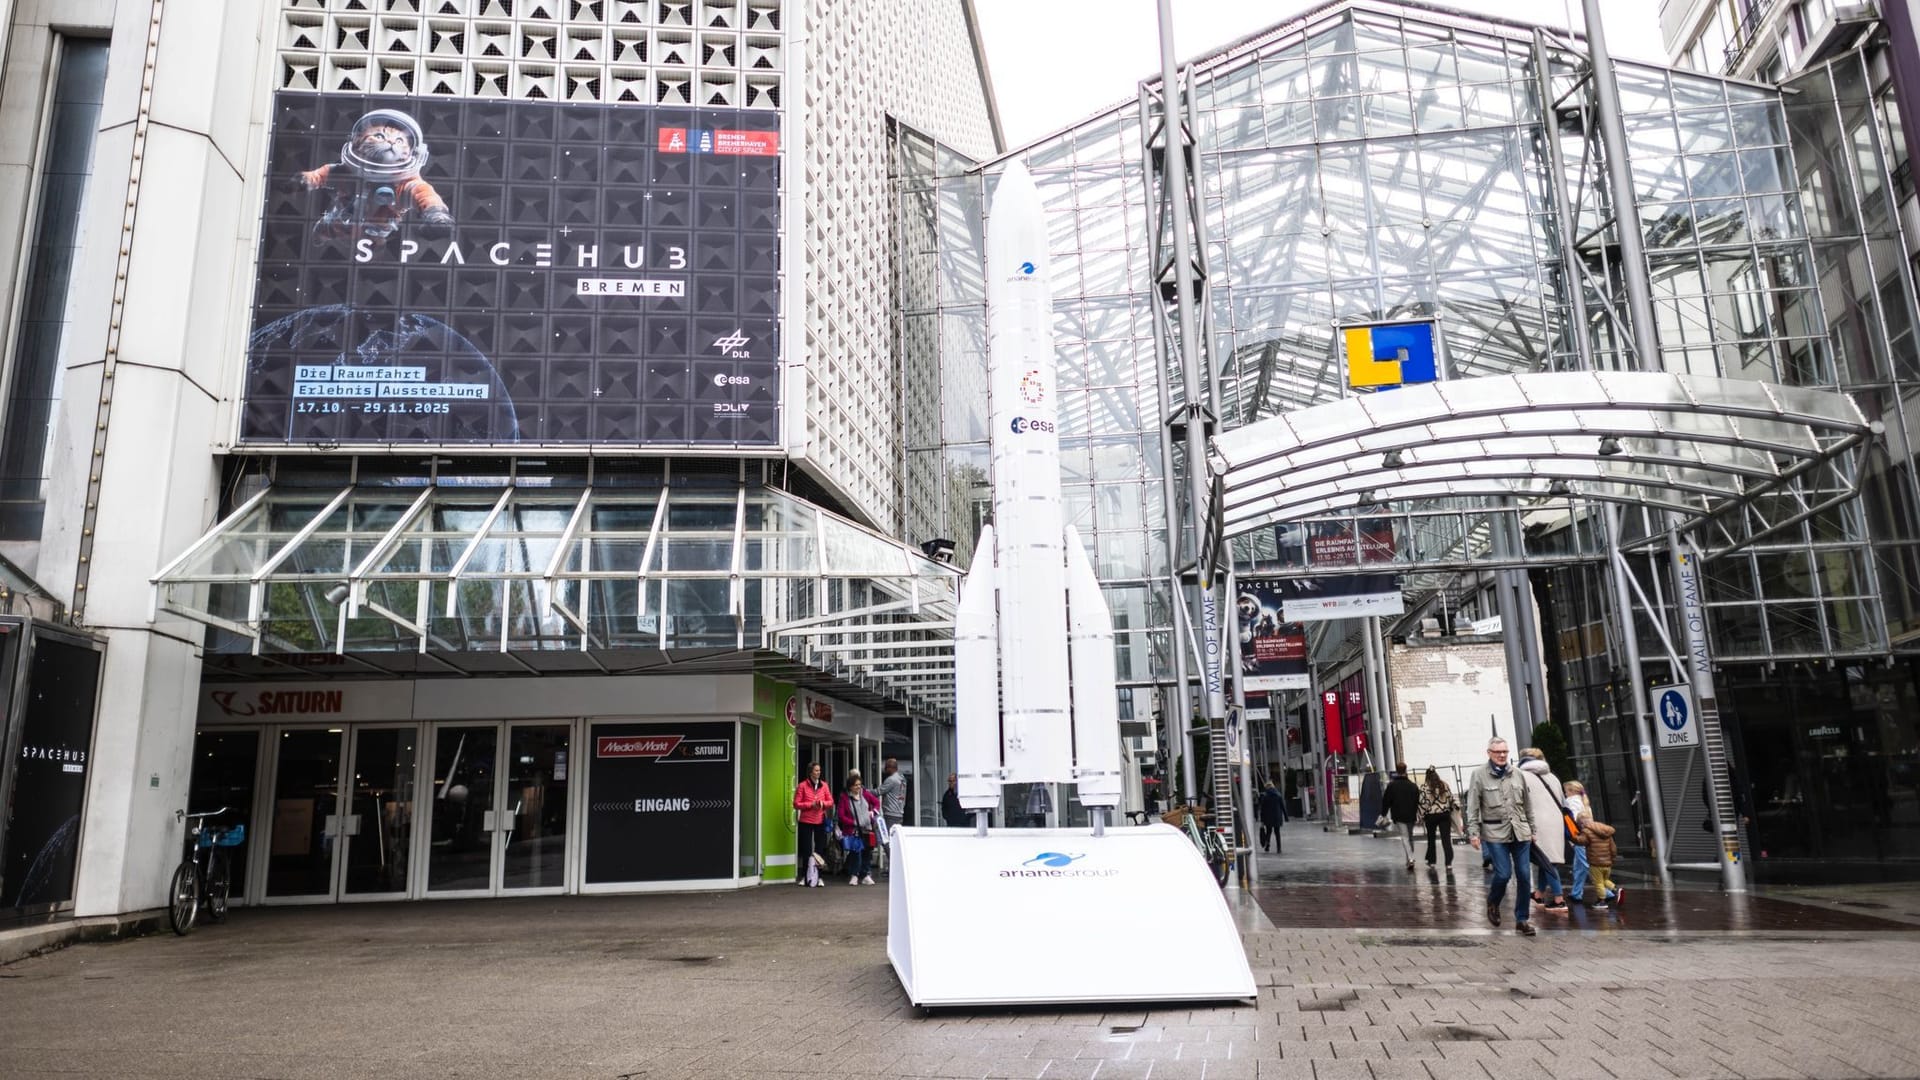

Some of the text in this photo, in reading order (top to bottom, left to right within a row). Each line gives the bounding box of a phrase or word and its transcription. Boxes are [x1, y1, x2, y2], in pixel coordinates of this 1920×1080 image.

[355, 239, 687, 269] SPACEHUB
[581, 281, 681, 294] BREMEN
[300, 368, 422, 380] Die Raumfahrt
[728, 376, 750, 385] esa
[299, 384, 484, 398] Erlebnis Ausstellung
[297, 402, 346, 413] 17.10.
[363, 402, 450, 413] 29.11.2025
[1030, 420, 1055, 433] esa
[1326, 538, 1364, 546] RAUMFAHT
[1347, 543, 1390, 552] AUSTELLUNG
[1681, 571, 1709, 673] MALL OF FAME
[1203, 596, 1221, 693] MALL OF FAME
[258, 690, 343, 714] SATURN
[1667, 732, 1689, 744] ZONE
[23, 747, 86, 762] SPACEHUB
[694, 745, 724, 756] SATURN
[634, 798, 691, 813] EINGANG
